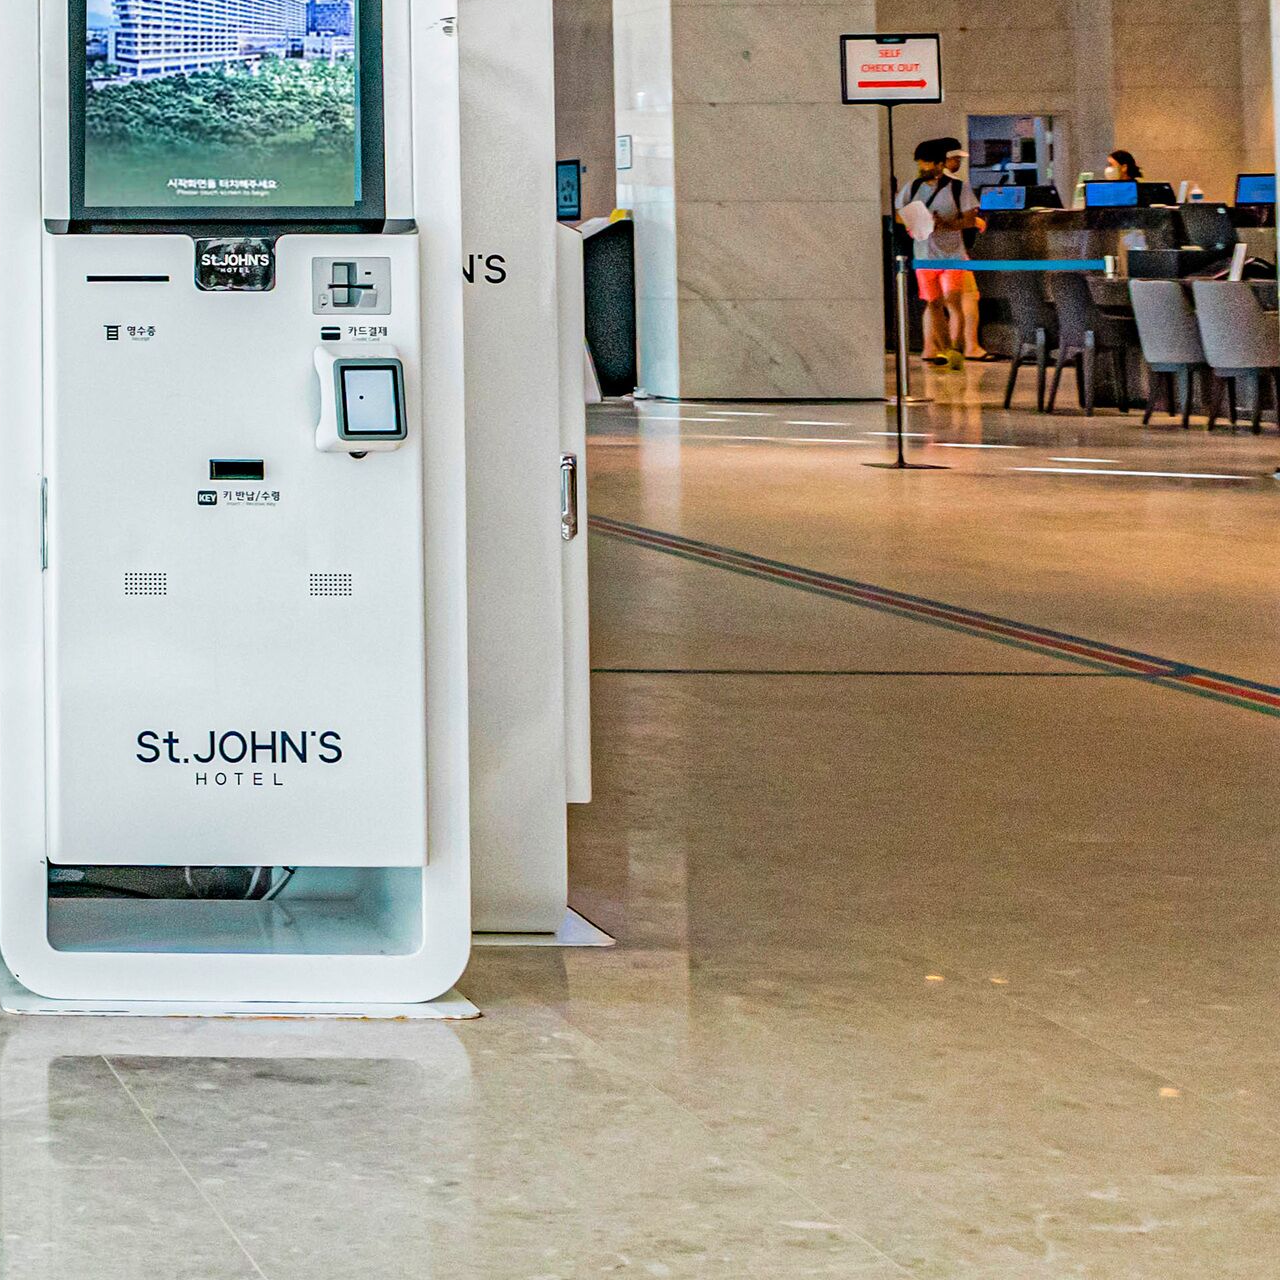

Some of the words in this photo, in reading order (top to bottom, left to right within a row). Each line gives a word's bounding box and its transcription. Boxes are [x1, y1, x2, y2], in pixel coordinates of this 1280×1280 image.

[878, 49, 902, 58] SELF
[861, 63, 894, 73] CHECK
[897, 63, 920, 72] OUT
[201, 253, 269, 267] St.JOHN'S
[126, 325, 156, 337] 영수증
[347, 326, 388, 337] 카드결제
[199, 493, 216, 502] KEY
[223, 490, 232, 501] 키
[235, 490, 280, 502] 반납/수령
[136, 730, 343, 764] St.JOHN'S
[195, 772, 284, 786] HOTEL
